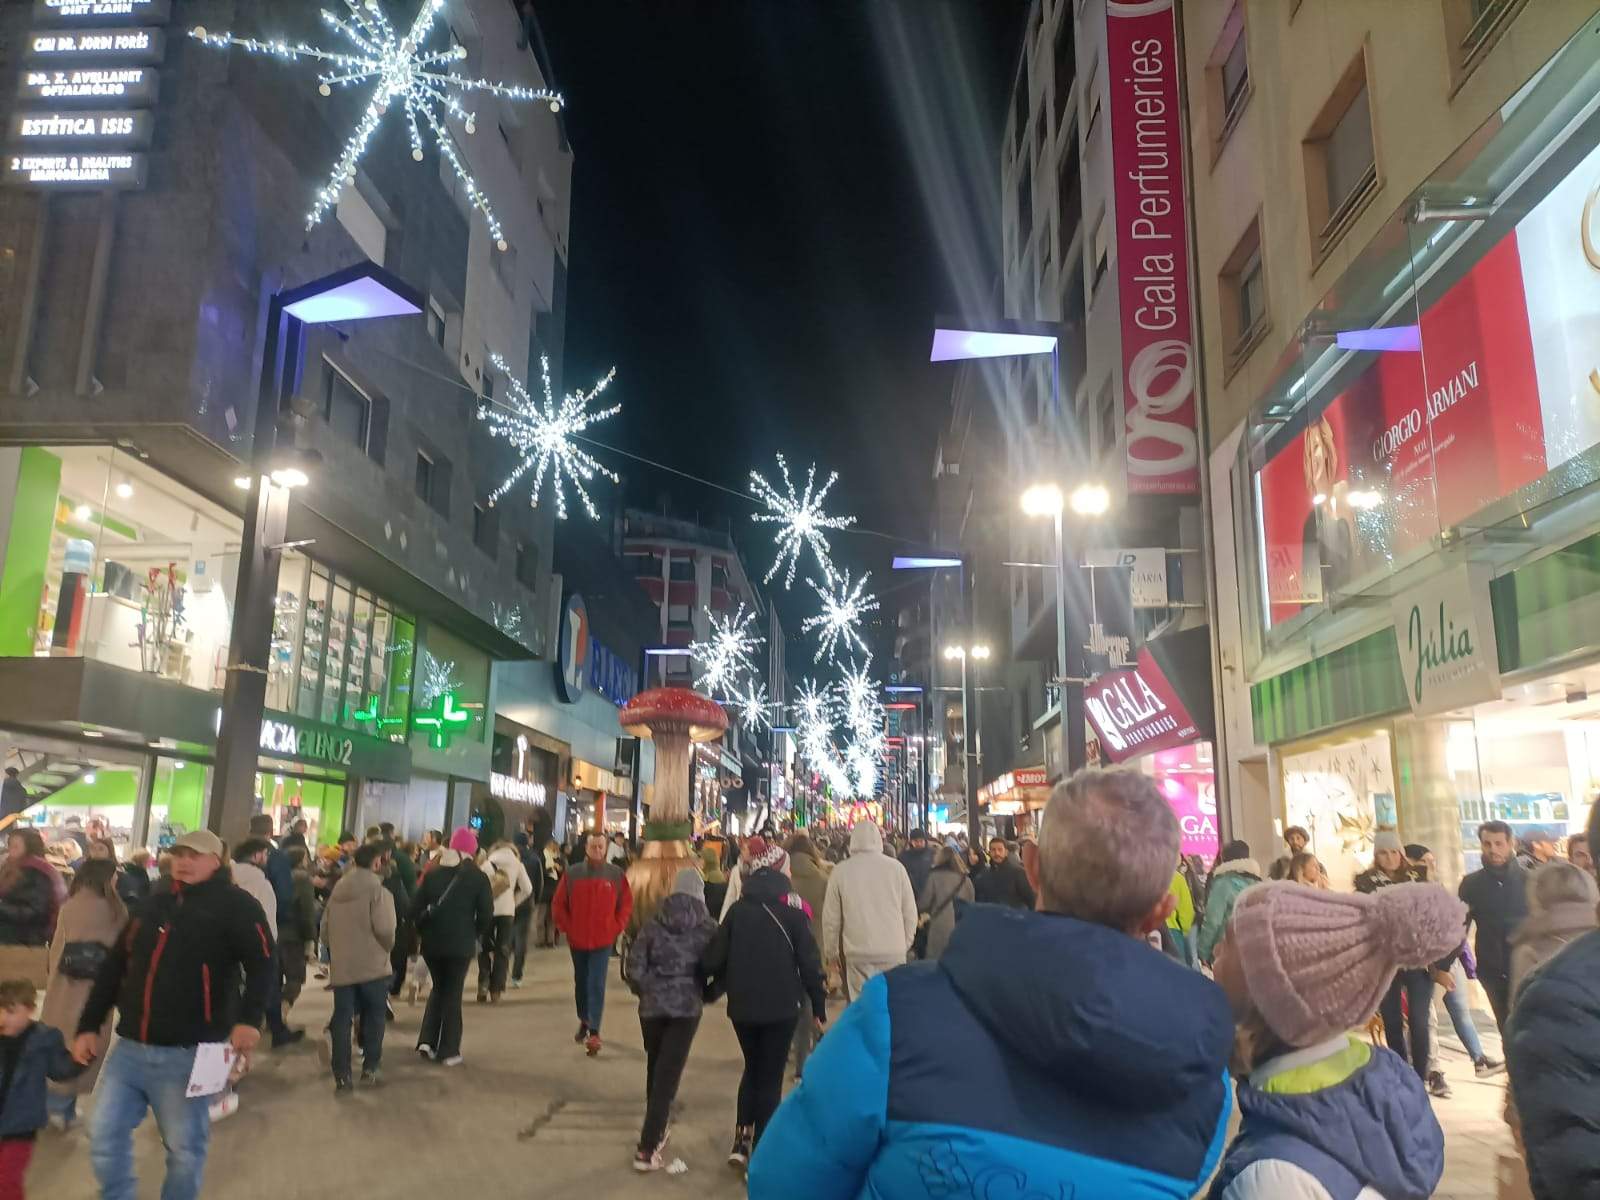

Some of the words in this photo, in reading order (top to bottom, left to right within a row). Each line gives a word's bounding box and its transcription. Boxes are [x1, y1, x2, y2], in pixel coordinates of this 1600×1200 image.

[79, 36, 112, 50] JORDI
[101, 118, 133, 134] ISIS
[1124, 39, 1172, 240] Perfumeries
[1134, 253, 1177, 331] Gala
[1373, 408, 1421, 461] GIORGIO
[1426, 361, 1479, 424] ARMANI
[1102, 670, 1167, 730] GALA
[260, 719, 297, 755] ACIA
